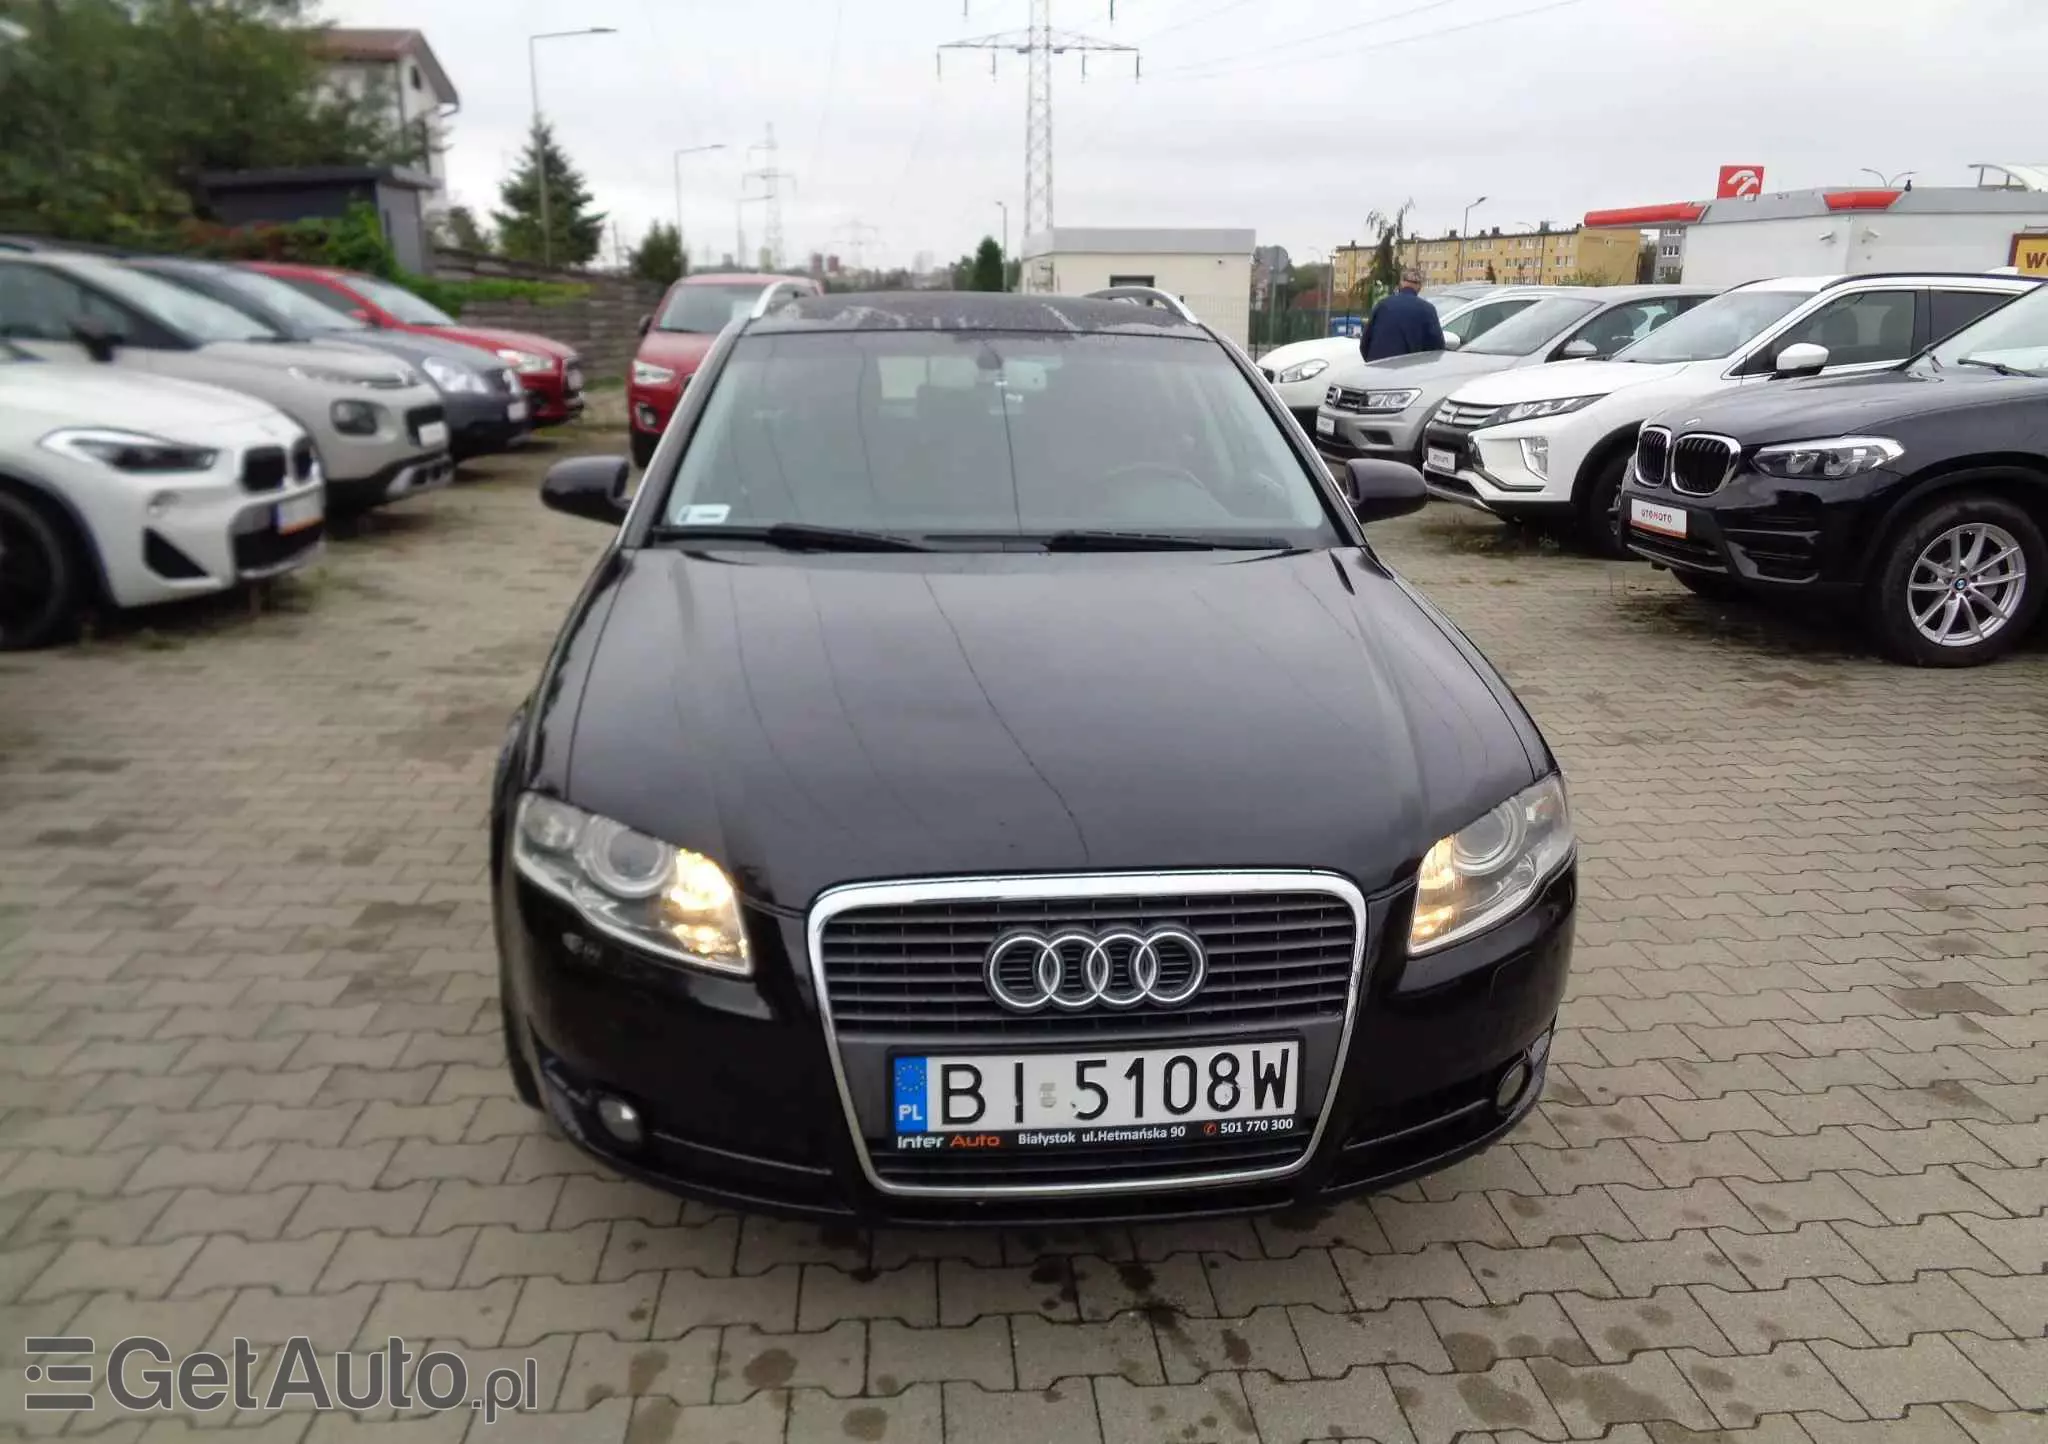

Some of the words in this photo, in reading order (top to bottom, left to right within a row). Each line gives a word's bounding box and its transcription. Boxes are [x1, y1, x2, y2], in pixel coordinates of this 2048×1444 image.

[2026, 252, 2048, 269] W
[1071, 1048, 1290, 1121] 5108W
[899, 1104, 923, 1121] PL
[1220, 1122, 1242, 1134] 501
[1246, 1120, 1268, 1132] 770
[1271, 1118, 1294, 1130] 300
[897, 1135, 944, 1149] Inter
[951, 1134, 1000, 1147] Auto
[1018, 1132, 1076, 1146] Białystok
[1170, 1126, 1186, 1137] 90
